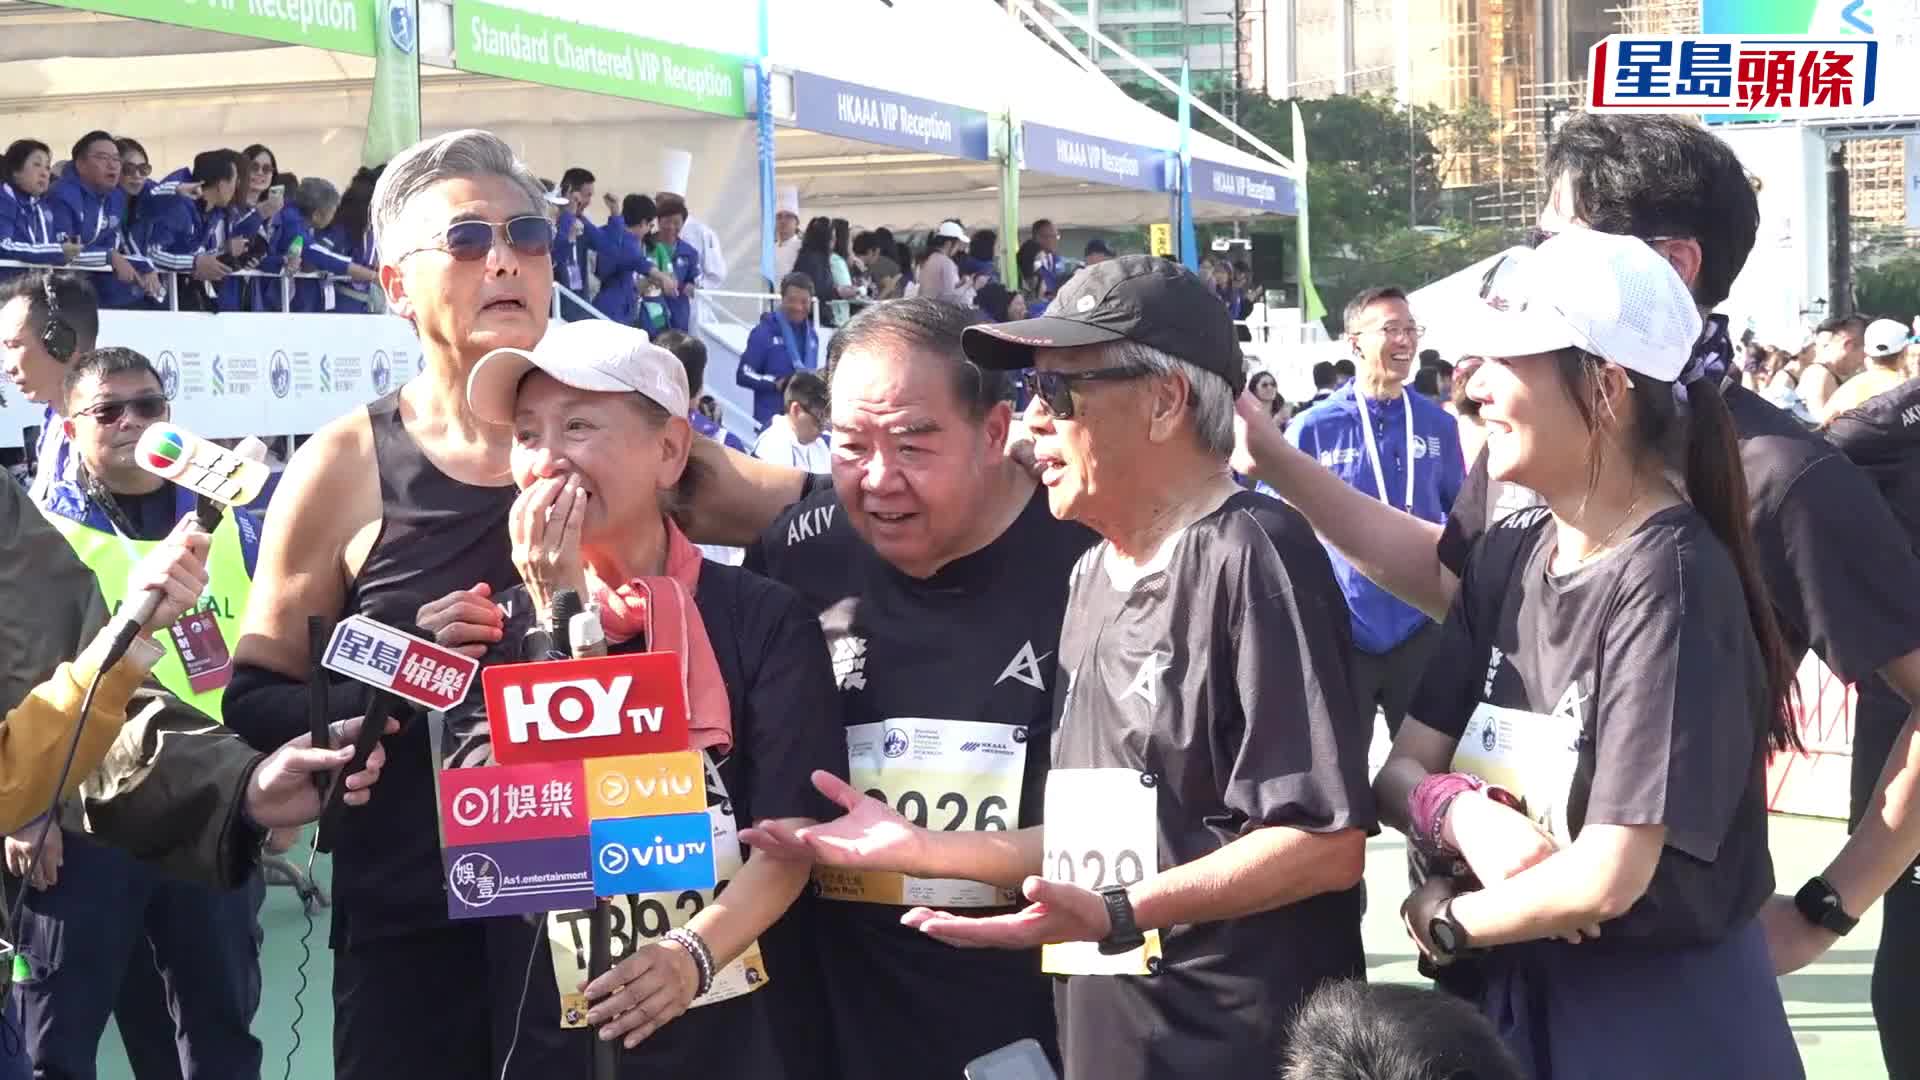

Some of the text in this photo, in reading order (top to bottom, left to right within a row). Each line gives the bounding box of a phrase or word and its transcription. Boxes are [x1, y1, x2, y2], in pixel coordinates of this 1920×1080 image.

[471, 15, 733, 103] Standard Chartered VIP Reception
[838, 92, 952, 145] HKAAA VIP Reception
[1056, 137, 1140, 181] HKAAA VIP Reception
[1246, 178, 1276, 206] Reception
[787, 504, 836, 547] AKIV
[336, 628, 467, 700] 星島娛樂
[503, 675, 664, 743] HOY TV
[635, 767, 694, 798] viu
[864, 788, 1009, 832] 926
[503, 870, 588, 886] As1.entertainment
